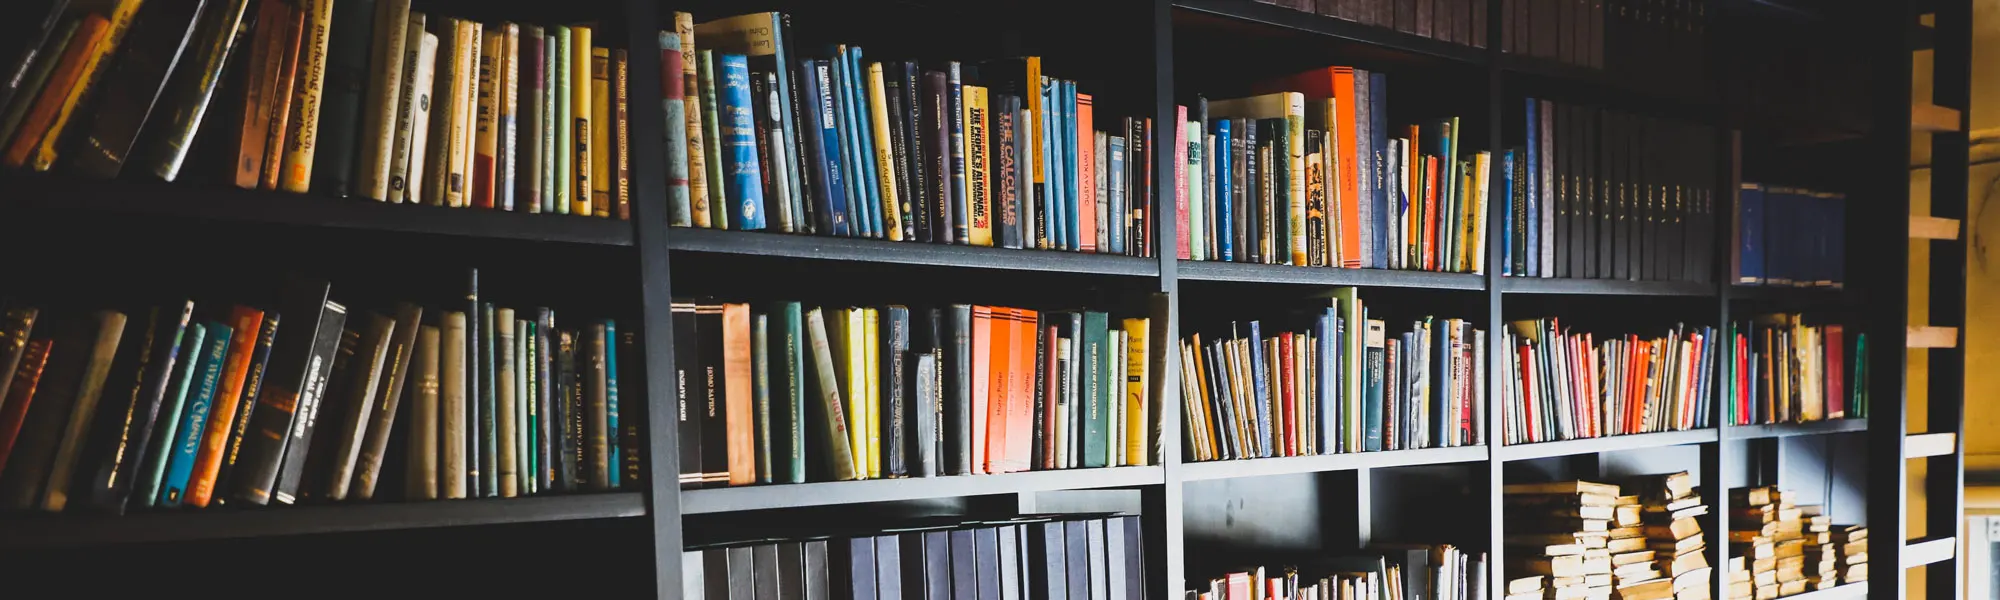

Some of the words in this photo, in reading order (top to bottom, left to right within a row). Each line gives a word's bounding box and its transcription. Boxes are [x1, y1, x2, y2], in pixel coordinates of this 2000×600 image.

[309, 24, 326, 91] marketing
[910, 75, 918, 112] Microsoft
[912, 113, 920, 139] Visual
[973, 108, 981, 127] THE
[1003, 112, 1013, 143] THE
[974, 127, 982, 169] PEOPLE'S
[880, 148, 890, 184] physics
[976, 171, 985, 217] ALMANAC
[1000, 180, 1008, 224] GEOMETRY
[1004, 145, 1016, 227] CALCULUS
[977, 219, 985, 229] 2
[211, 339, 227, 361] THE
[529, 335, 537, 350] THE
[786, 333, 795, 372] CALCULUS
[199, 363, 219, 401] WHITE
[247, 362, 263, 398] GLACIER
[677, 369, 687, 400] SAPIENS
[706, 366, 715, 388] HOMO
[529, 382, 537, 416] GARDEN
[679, 399, 688, 422] HOMO
[707, 388, 716, 417] SAPIENS
[830, 391, 845, 433] RADIO
[995, 394, 1003, 416] Harry
[236, 399, 253, 435] PROJECT
[228, 435, 244, 465] PAPERS
